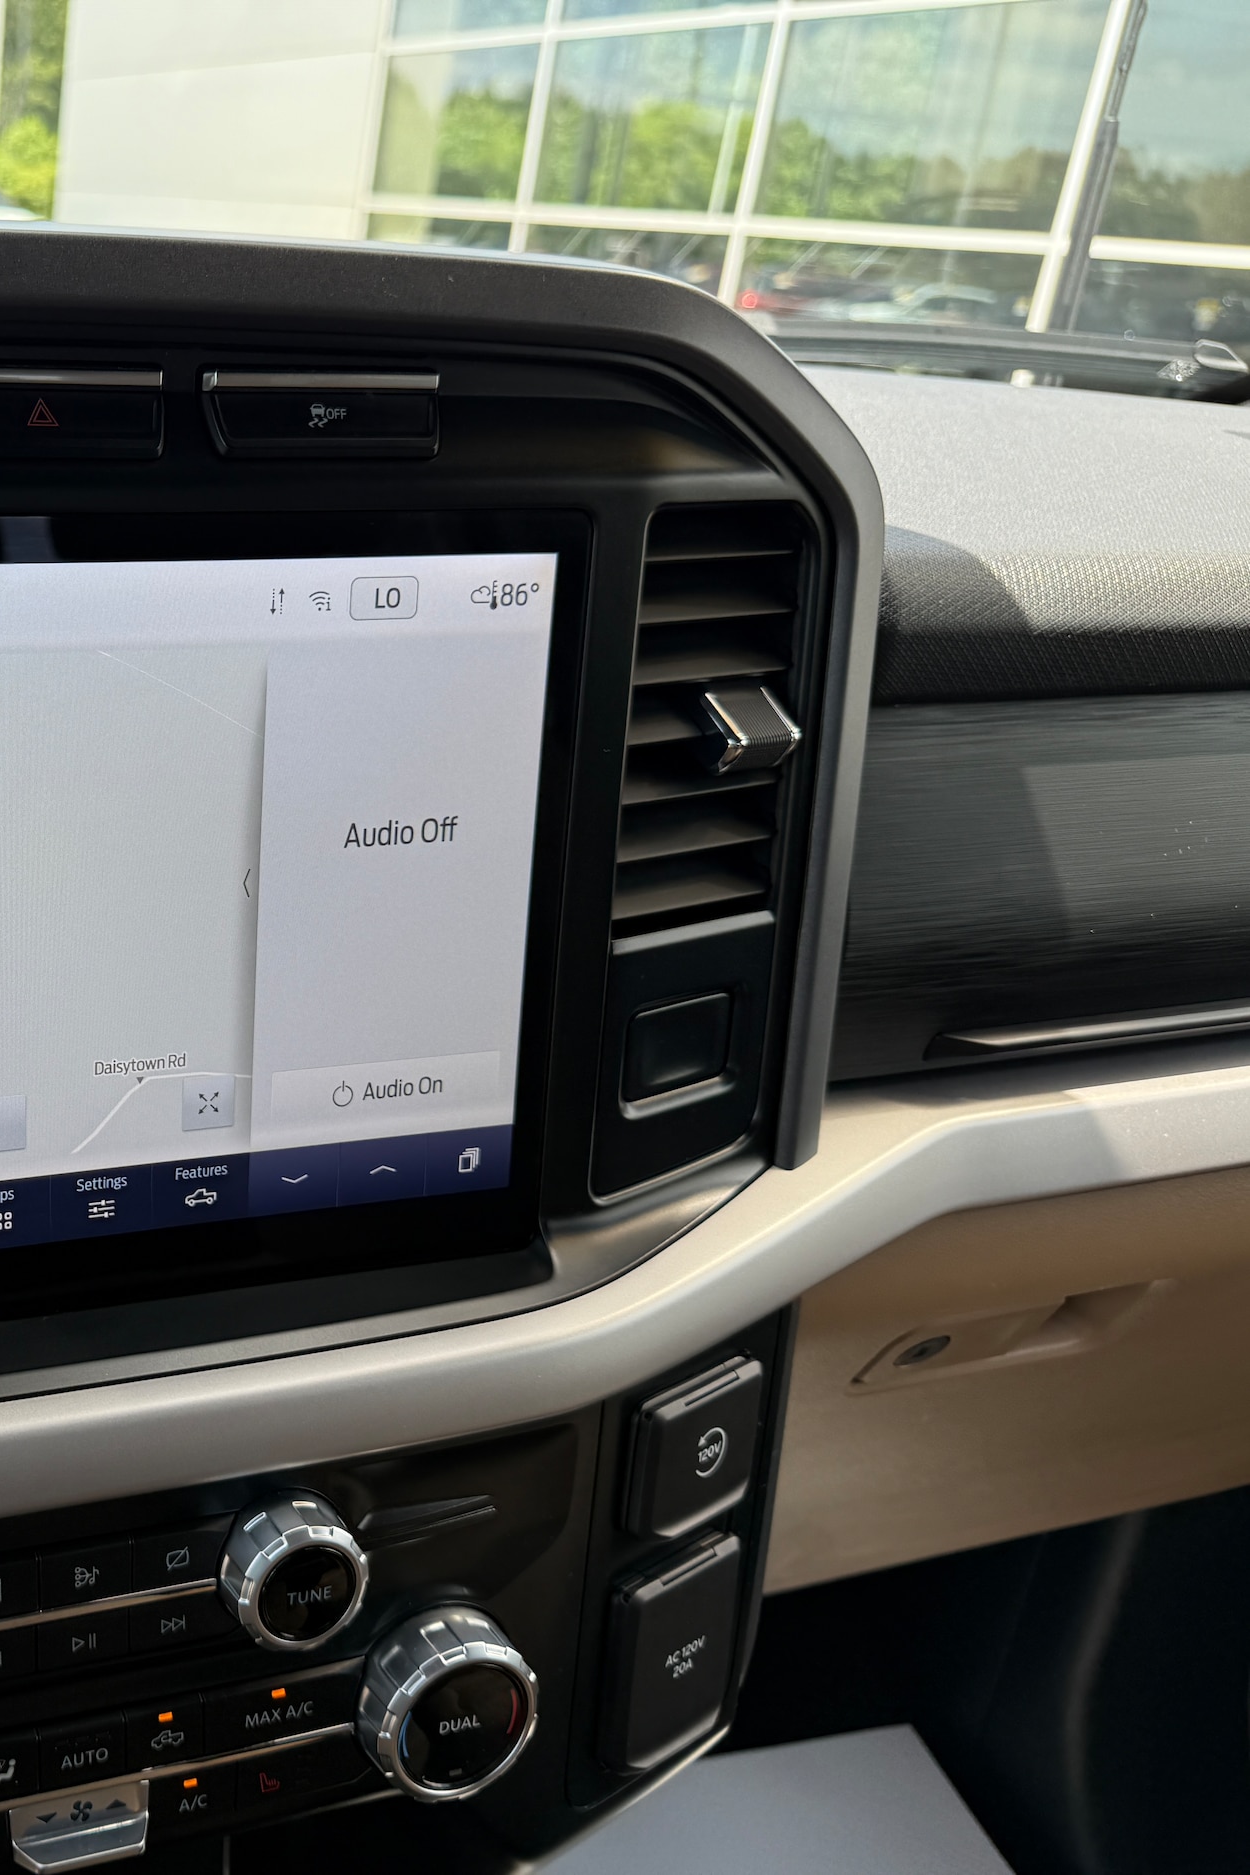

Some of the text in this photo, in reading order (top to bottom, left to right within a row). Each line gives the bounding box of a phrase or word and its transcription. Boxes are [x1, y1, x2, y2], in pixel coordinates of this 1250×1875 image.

[326, 408, 345, 419] OFF
[374, 588, 401, 609] LO
[344, 816, 458, 848] Audio Off
[94, 1053, 186, 1077] Daisytown Rd
[362, 1076, 443, 1101] Audio On
[175, 1163, 228, 1181] Features
[76, 1174, 128, 1194] Settings
[698, 1441, 722, 1462] 120V
[287, 1585, 332, 1606] TUNE
[665, 1636, 705, 1667] AC 120V
[673, 1658, 692, 1677] 20A
[245, 1701, 313, 1729] MAX A/C
[438, 1714, 480, 1735] DUAL
[61, 1748, 108, 1770] AUTO
[179, 1793, 207, 1812] A/C
